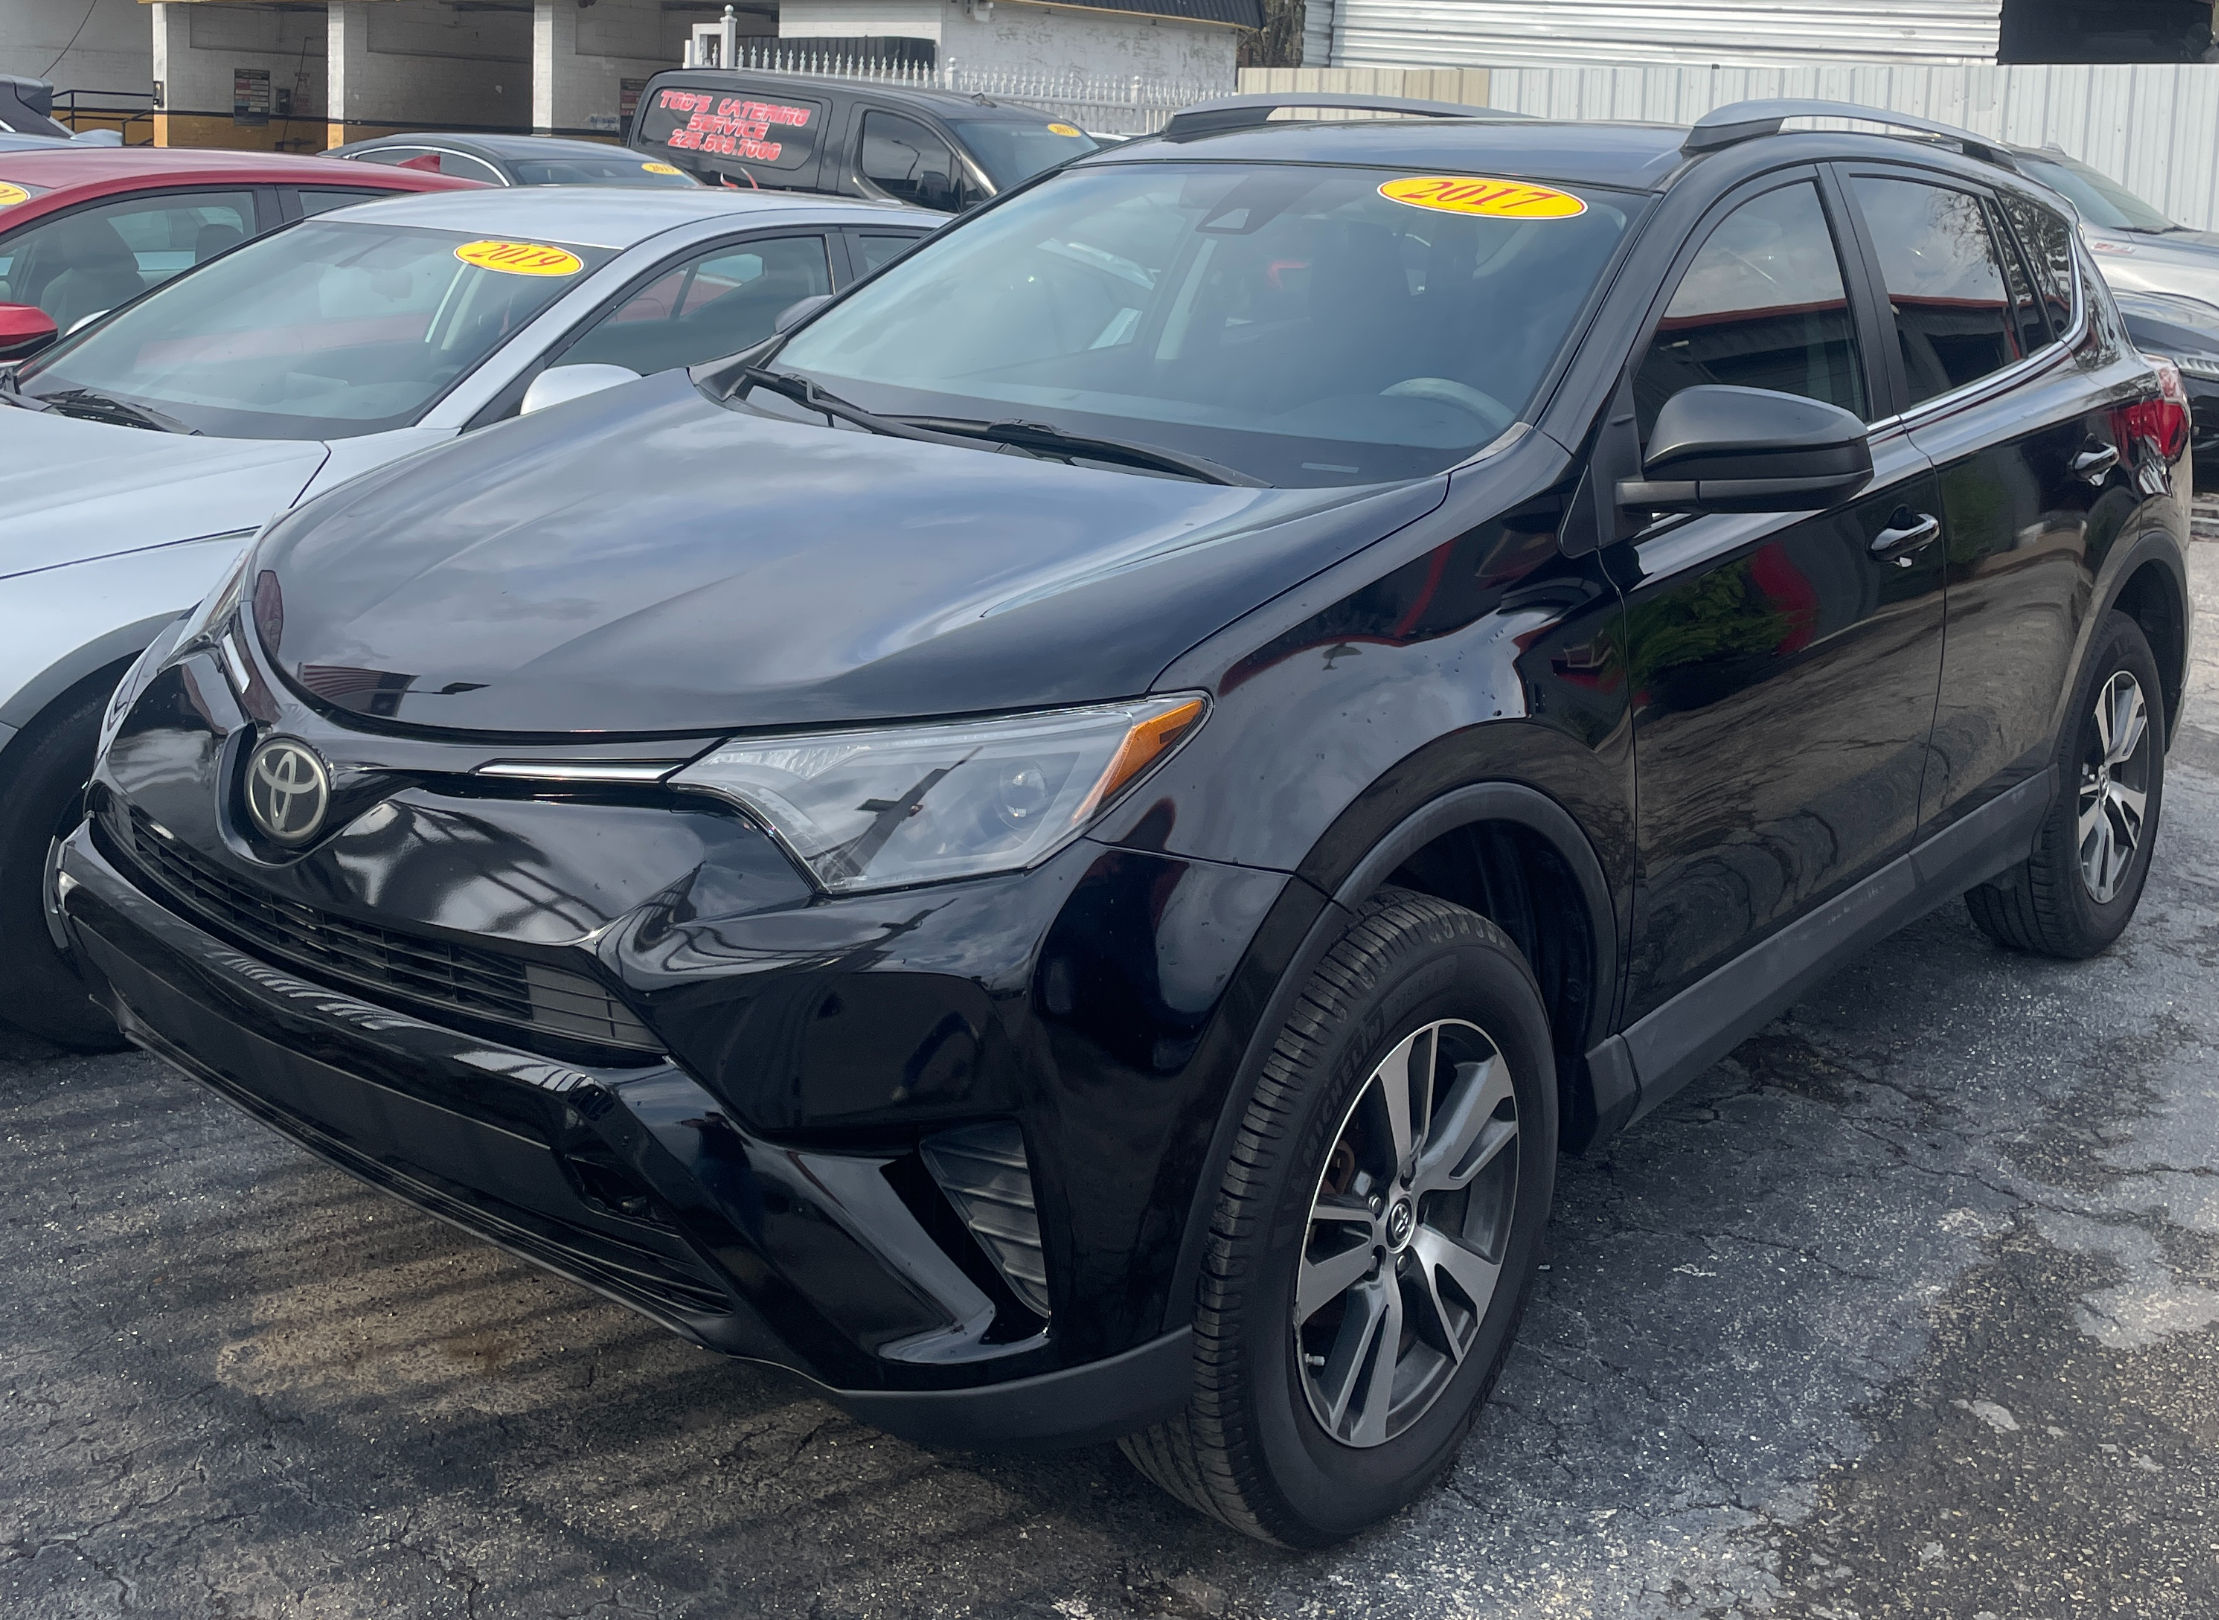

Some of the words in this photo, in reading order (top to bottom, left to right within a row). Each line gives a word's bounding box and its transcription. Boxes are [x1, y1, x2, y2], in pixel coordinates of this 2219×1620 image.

[718, 98, 811, 127] CATERING
[687, 114, 769, 140] SERVICE
[1400, 181, 1560, 209] 2017
[467, 244, 568, 267] 2019
